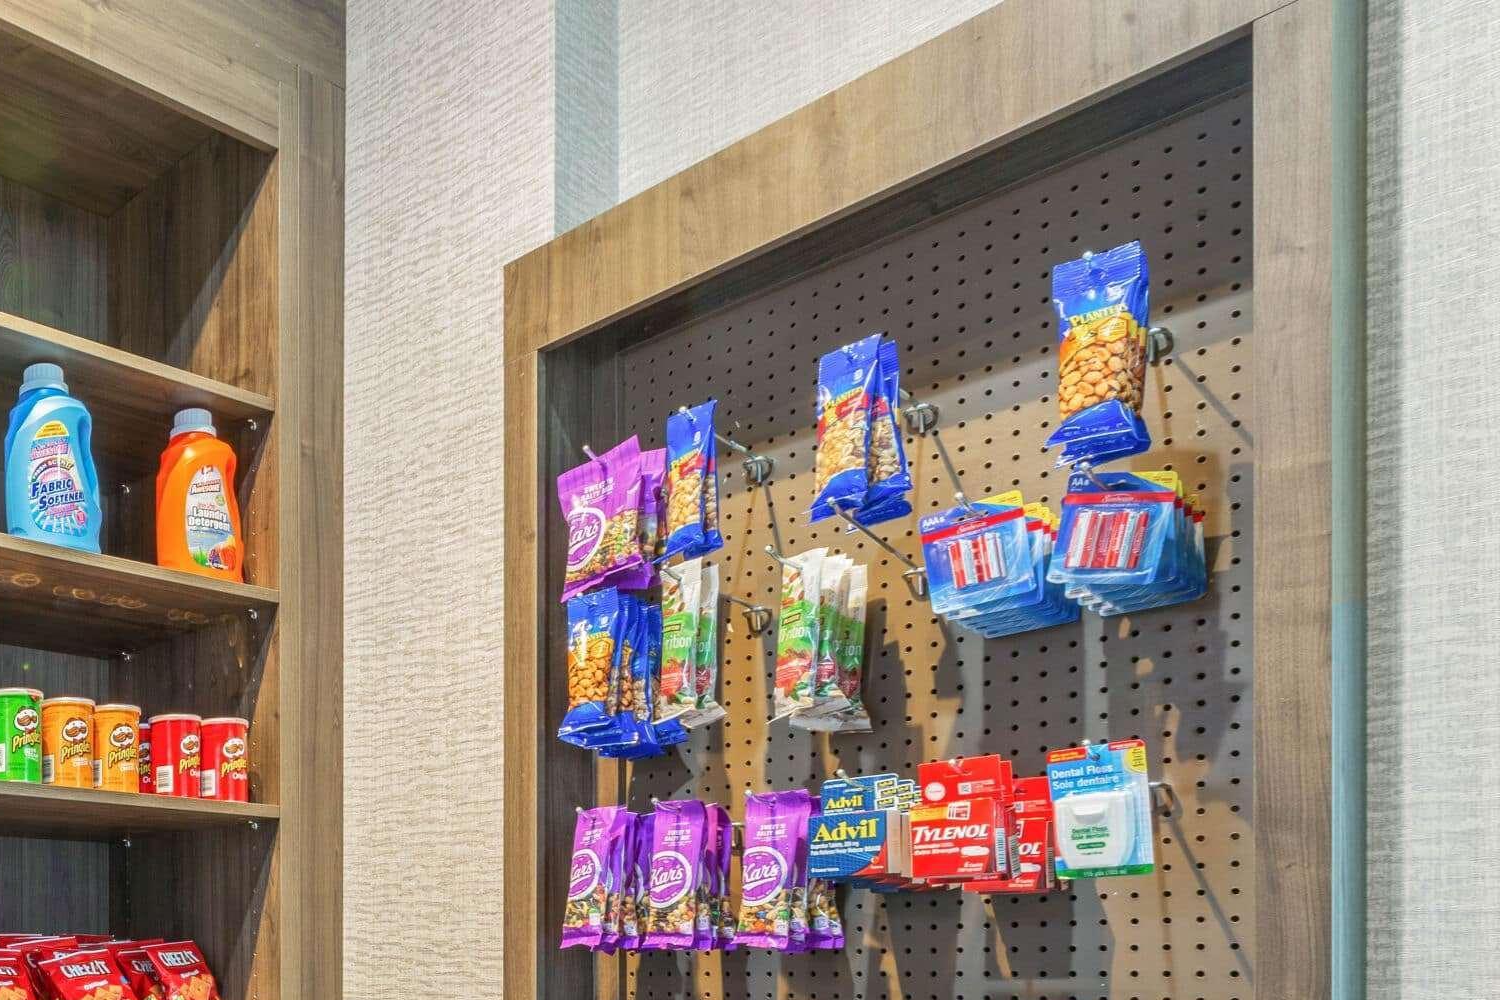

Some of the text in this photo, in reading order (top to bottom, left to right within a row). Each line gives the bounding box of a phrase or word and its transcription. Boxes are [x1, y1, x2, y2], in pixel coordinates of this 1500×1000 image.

[31, 479, 73, 497] FABRIC
[38, 492, 84, 510] SOFTENER
[193, 505, 228, 523] Laundry
[1051, 763, 1114, 779] Dental Floss
[1077, 774, 1120, 787] dentaire
[825, 795, 863, 810] Advil
[812, 818, 879, 842] Advil
[912, 824, 990, 845] TYLENOL
[651, 866, 684, 884] Kar's
[743, 861, 780, 878] Kar's
